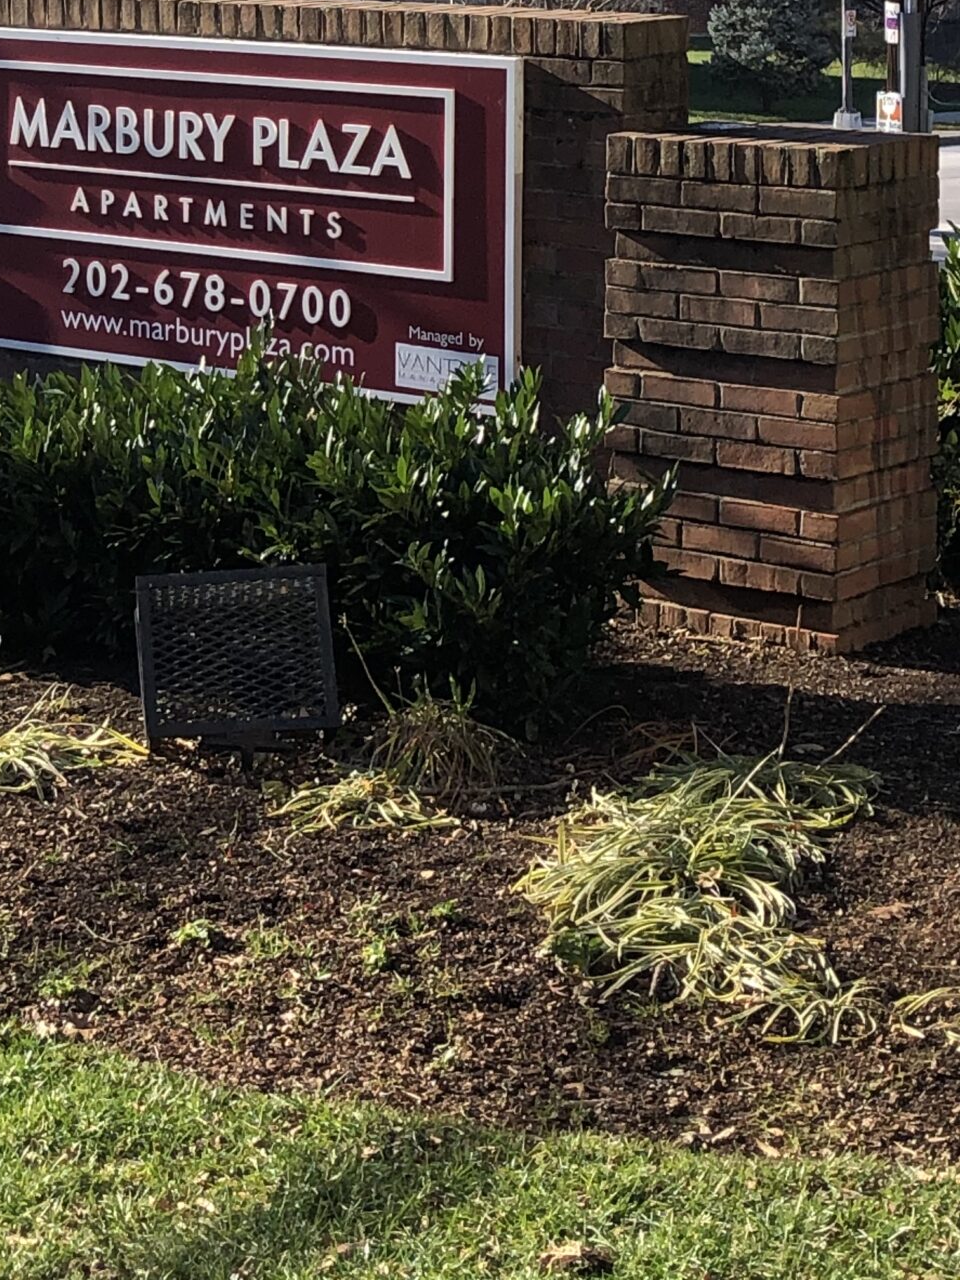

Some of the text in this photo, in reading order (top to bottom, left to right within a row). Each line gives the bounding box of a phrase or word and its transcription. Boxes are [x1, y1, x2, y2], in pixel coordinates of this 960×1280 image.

[9, 95, 412, 180] MARBURY PLAZA
[70, 186, 343, 240] APARTMENTS
[61, 257, 352, 329] 202-678-0700
[60, 308, 355, 367] www.marburyplza.com
[408, 324, 484, 352] Managed by
